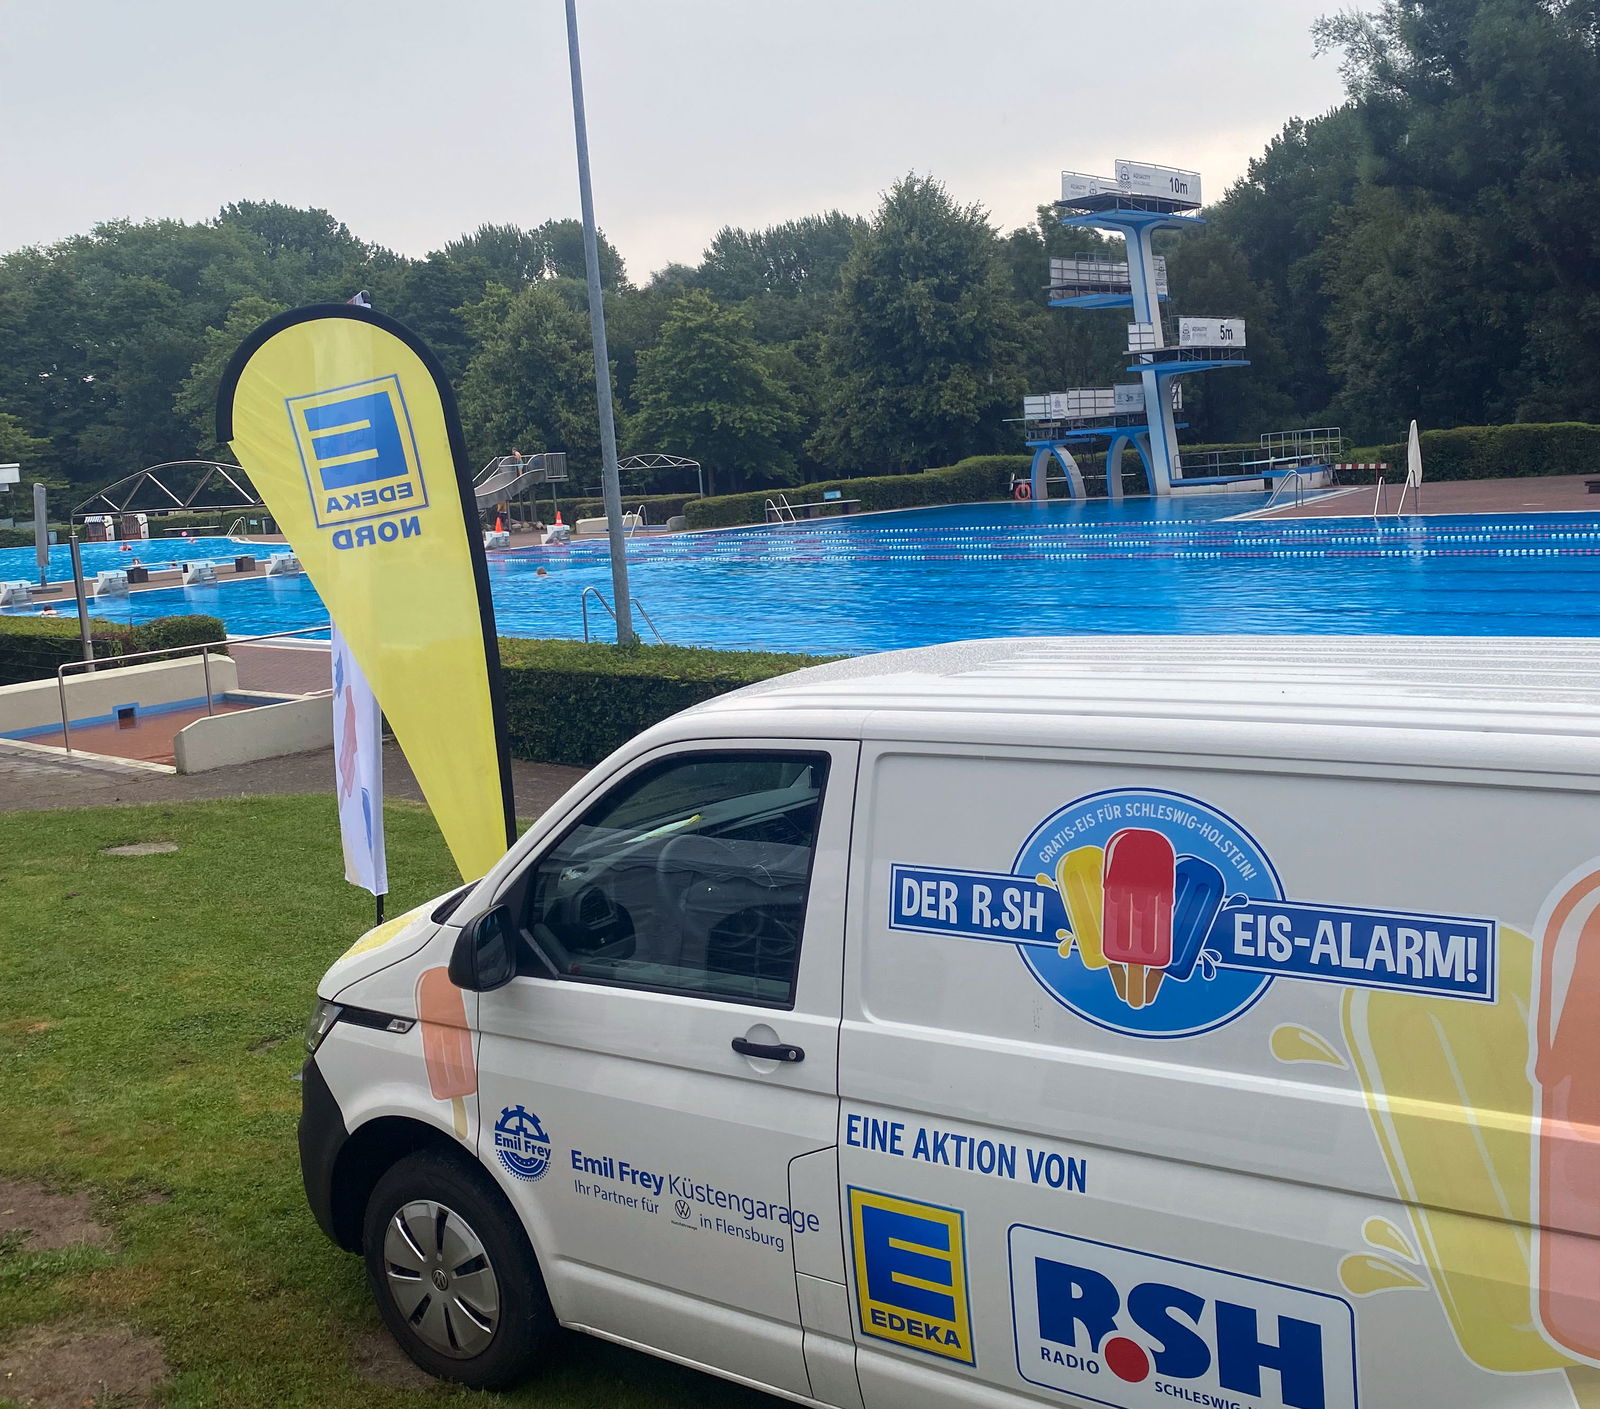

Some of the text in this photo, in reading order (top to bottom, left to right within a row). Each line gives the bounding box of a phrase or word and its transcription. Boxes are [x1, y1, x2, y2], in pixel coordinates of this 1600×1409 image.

[1169, 176, 1188, 196] 10m
[1220, 324, 1233, 340] 5m
[1039, 803, 1257, 881] GRATIS-EIS FÜR SCHLESWIG-HOLSTEIN!
[901, 877, 1045, 933] DER R.SH
[1234, 913, 1478, 983] EIS-ALARM!
[494, 1132, 552, 1161] Emil Frey
[847, 1113, 1087, 1194] EINE AKTION VON
[571, 1149, 820, 1233] Emil Frey Küstengarage
[574, 1179, 660, 1215] Ihr Partner für
[700, 1213, 712, 1230] in
[716, 1218, 785, 1252] Flensburg
[870, 1308, 962, 1350] EDEKA
[1040, 1346, 1100, 1375] RADIO
